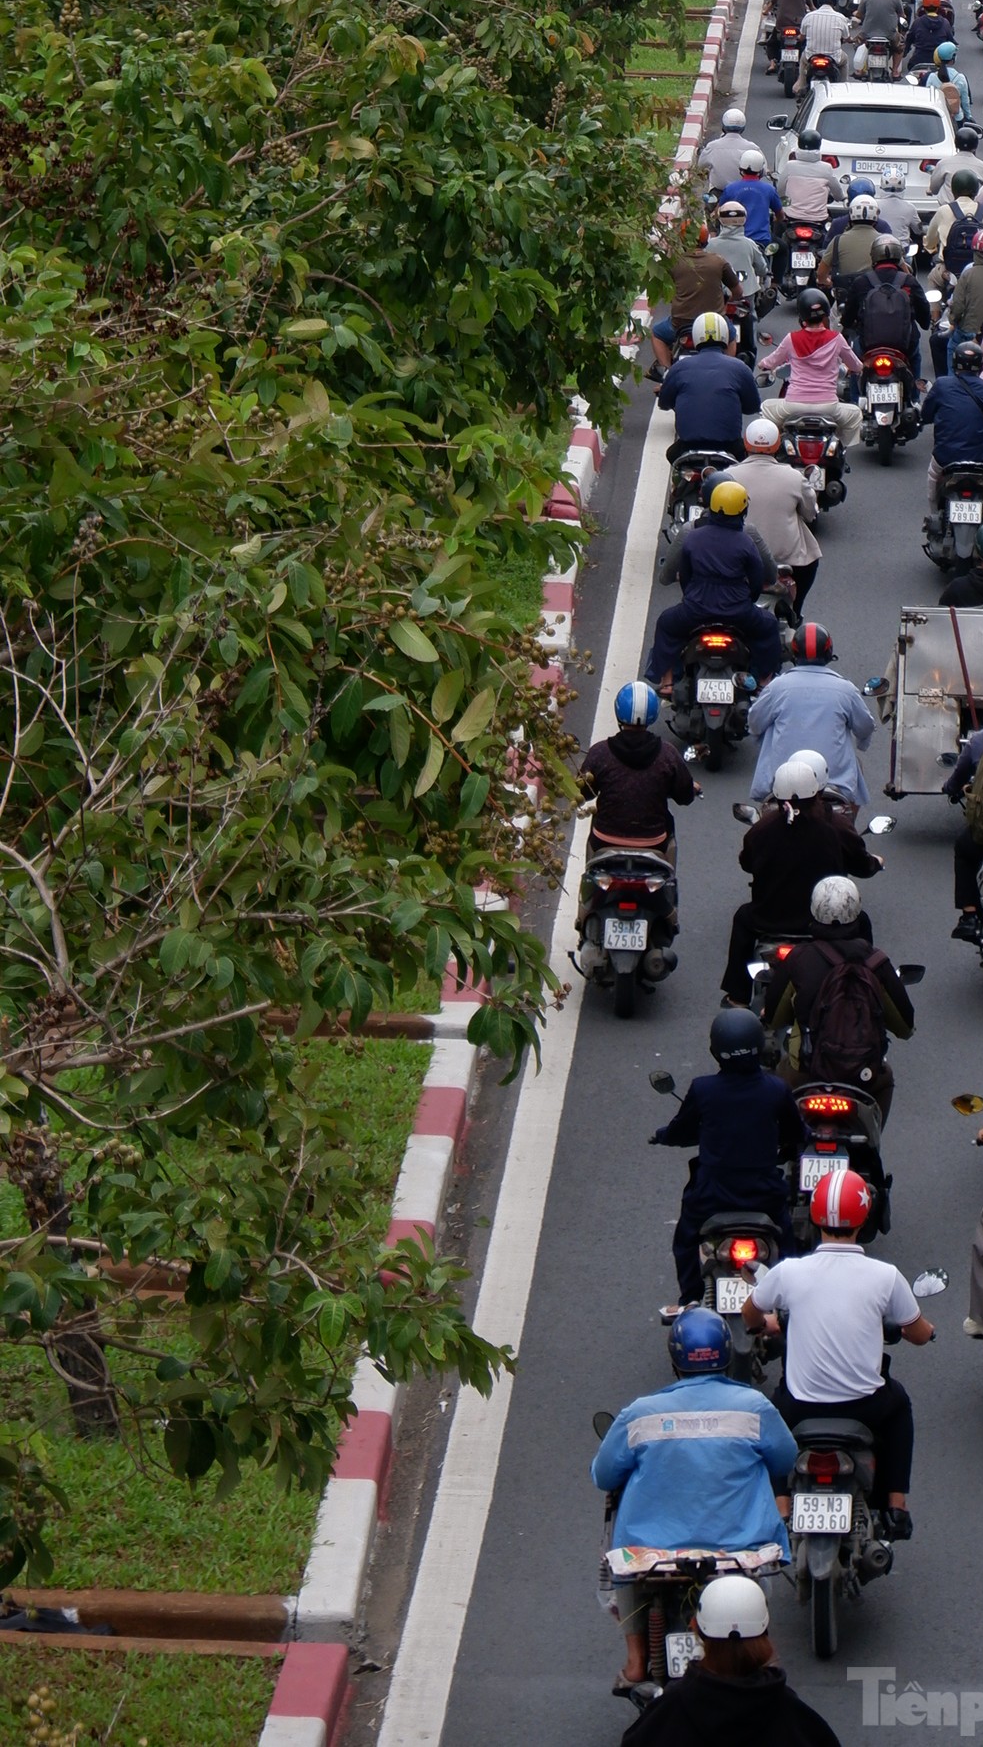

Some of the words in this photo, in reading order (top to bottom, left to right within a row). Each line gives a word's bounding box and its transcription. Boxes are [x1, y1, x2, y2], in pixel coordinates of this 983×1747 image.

[871, 393, 897, 403] 168.55
[954, 503, 977, 512] 59-N2
[951, 512, 980, 522] 789.03
[703, 680, 728, 691] 74-C1
[611, 921, 641, 934] 59-N2
[607, 934, 644, 947] 475.05
[807, 1158, 841, 1175] 71-H1
[803, 1497, 843, 1513] 59-N3
[797, 1513, 847, 1530] 033.60
